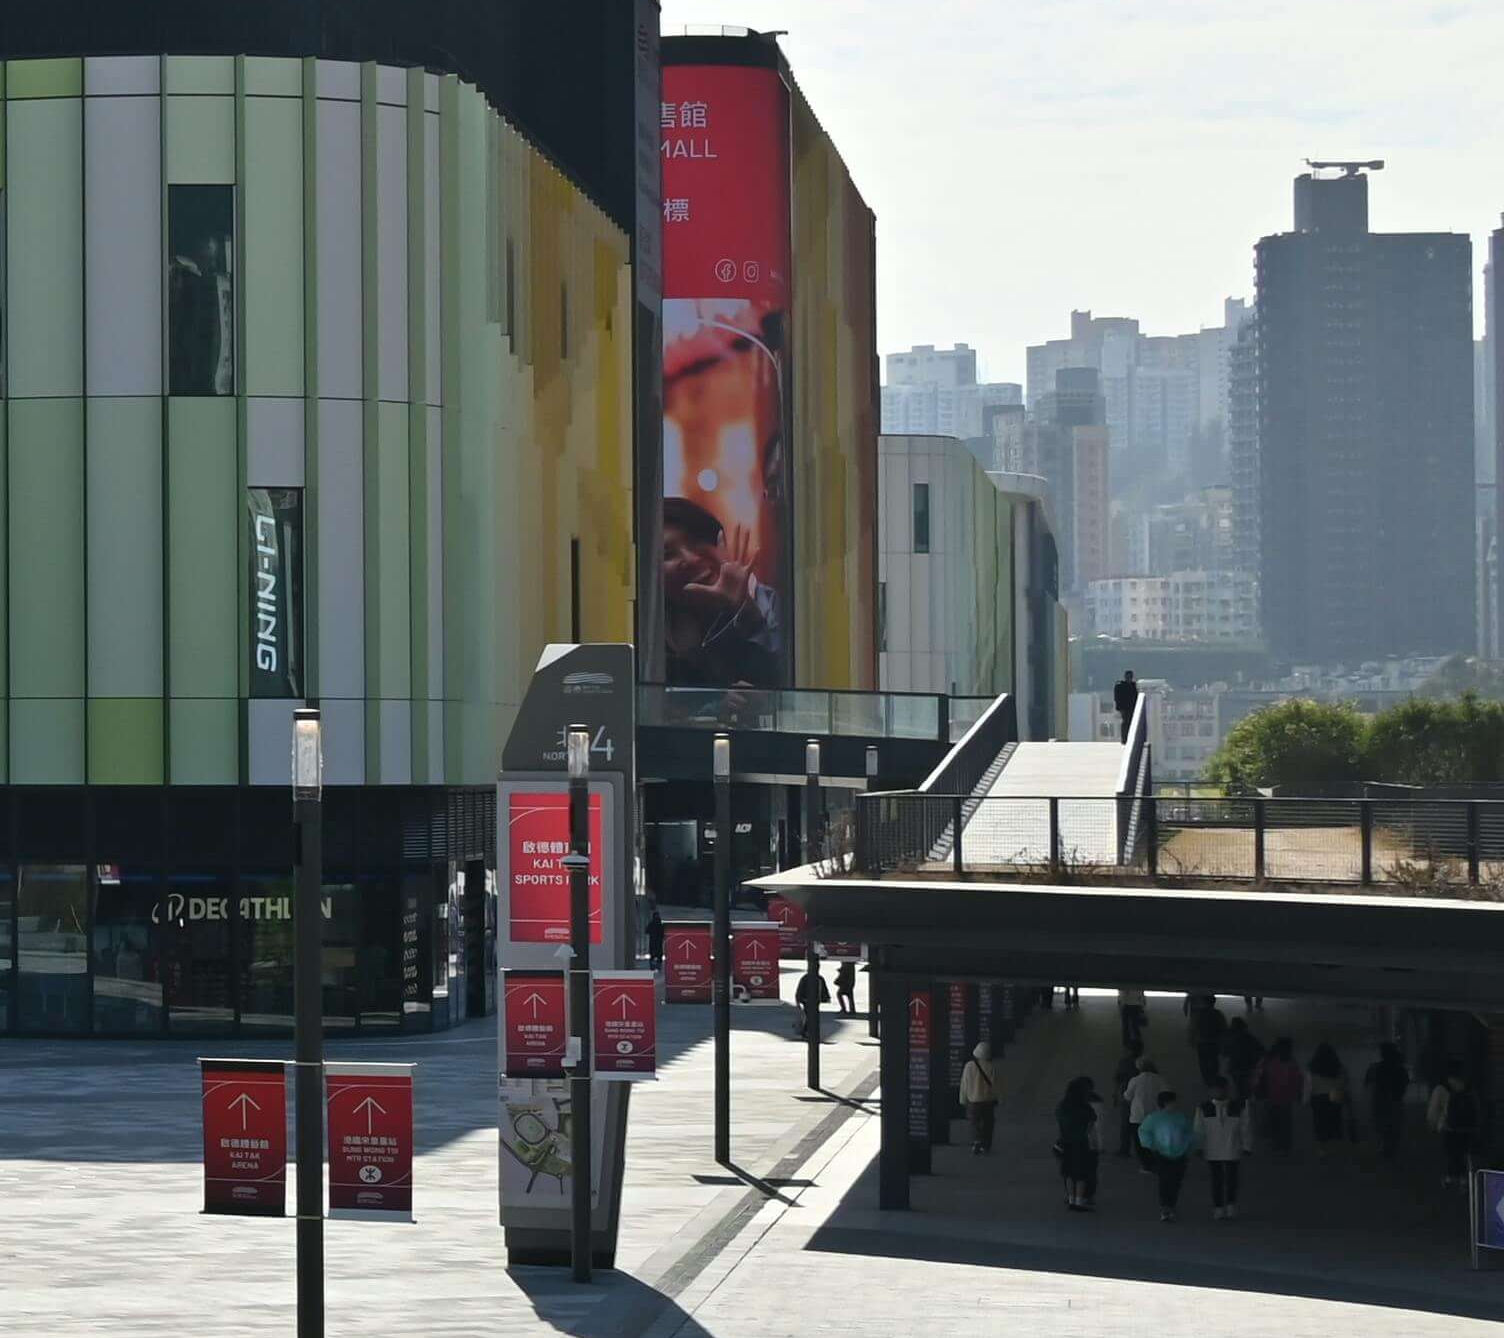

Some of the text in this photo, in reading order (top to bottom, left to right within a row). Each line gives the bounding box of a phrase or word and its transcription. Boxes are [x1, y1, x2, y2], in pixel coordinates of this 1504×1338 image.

[255, 515, 277, 673] LI-NING
[591, 725, 614, 761] 4
[533, 858, 553, 869] KAI
[515, 874, 563, 885] SPORTS
[189, 897, 332, 920] DECATHLN
